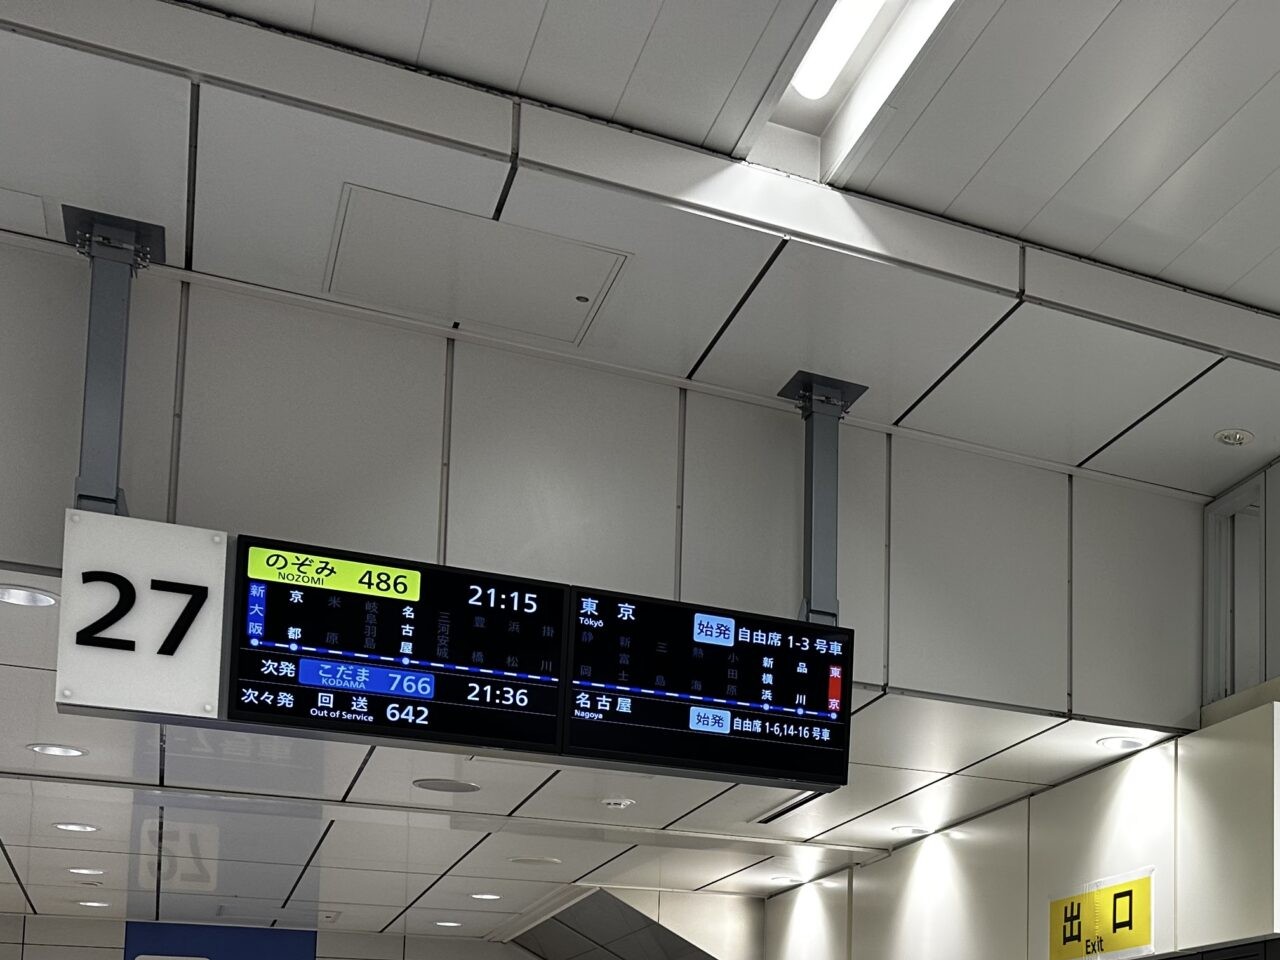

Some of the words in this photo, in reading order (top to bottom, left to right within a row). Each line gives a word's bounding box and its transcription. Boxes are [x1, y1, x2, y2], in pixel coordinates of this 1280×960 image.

[266, 553, 337, 578] のぞみ
[358, 570, 408, 595] 486
[278, 571, 324, 586] NOZOMI
[248, 585, 265, 636] 新大阪
[468, 585, 537, 613] 21:15
[580, 597, 636, 621] 東京
[74, 570, 209, 657] 27
[287, 590, 304, 640] 京都
[400, 605, 415, 654] 名古屋
[697, 619, 731, 640] 始発
[738, 627, 782, 647] 自由席
[788, 635, 810, 651] 1-3
[814, 638, 843, 656] 号車
[261, 659, 296, 678] 次発
[318, 663, 370, 683] こだま
[388, 673, 431, 695] 766
[761, 656, 774, 701] 新横浜
[321, 677, 366, 690] KODAMA
[467, 682, 529, 706] 21:36
[795, 662, 808, 705] 品川
[828, 666, 841, 711] 東京
[241, 688, 294, 708] 次々発
[318, 692, 368, 712] 回送
[386, 703, 429, 725] 642
[575, 692, 632, 714] 名古屋
[310, 708, 328, 718] Out
[330, 710, 340, 718] of
[341, 711, 374, 722] Service
[574, 709, 603, 720] Nagoya
[696, 712, 724, 728] 始発
[733, 717, 762, 733] 自由席
[812, 726, 830, 741] 号車
[1063, 889, 1133, 946] 出口
[1085, 936, 1104, 955] Exit
